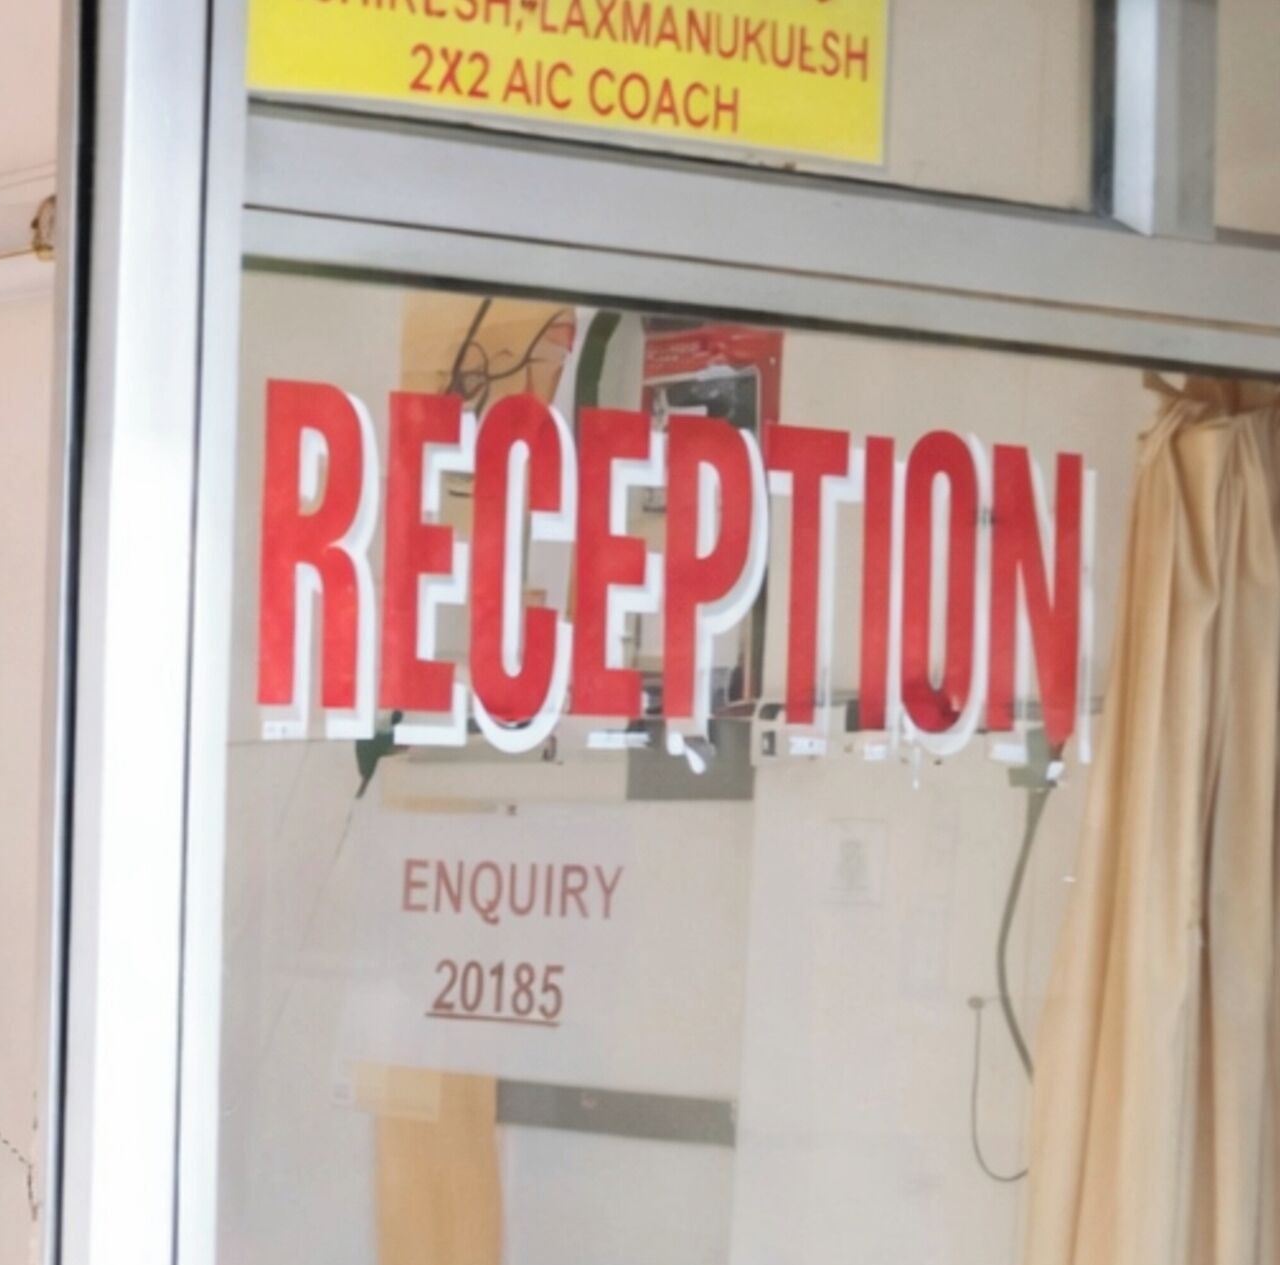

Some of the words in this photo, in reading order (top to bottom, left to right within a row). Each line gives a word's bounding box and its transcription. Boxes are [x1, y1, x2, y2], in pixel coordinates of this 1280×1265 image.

[408, 43, 491, 100] 2X2
[588, 67, 741, 134] COACH
[256, 378, 1090, 755] RECEPTION
[400, 857, 625, 926] ENQUIRY
[428, 958, 566, 1022] 20185
